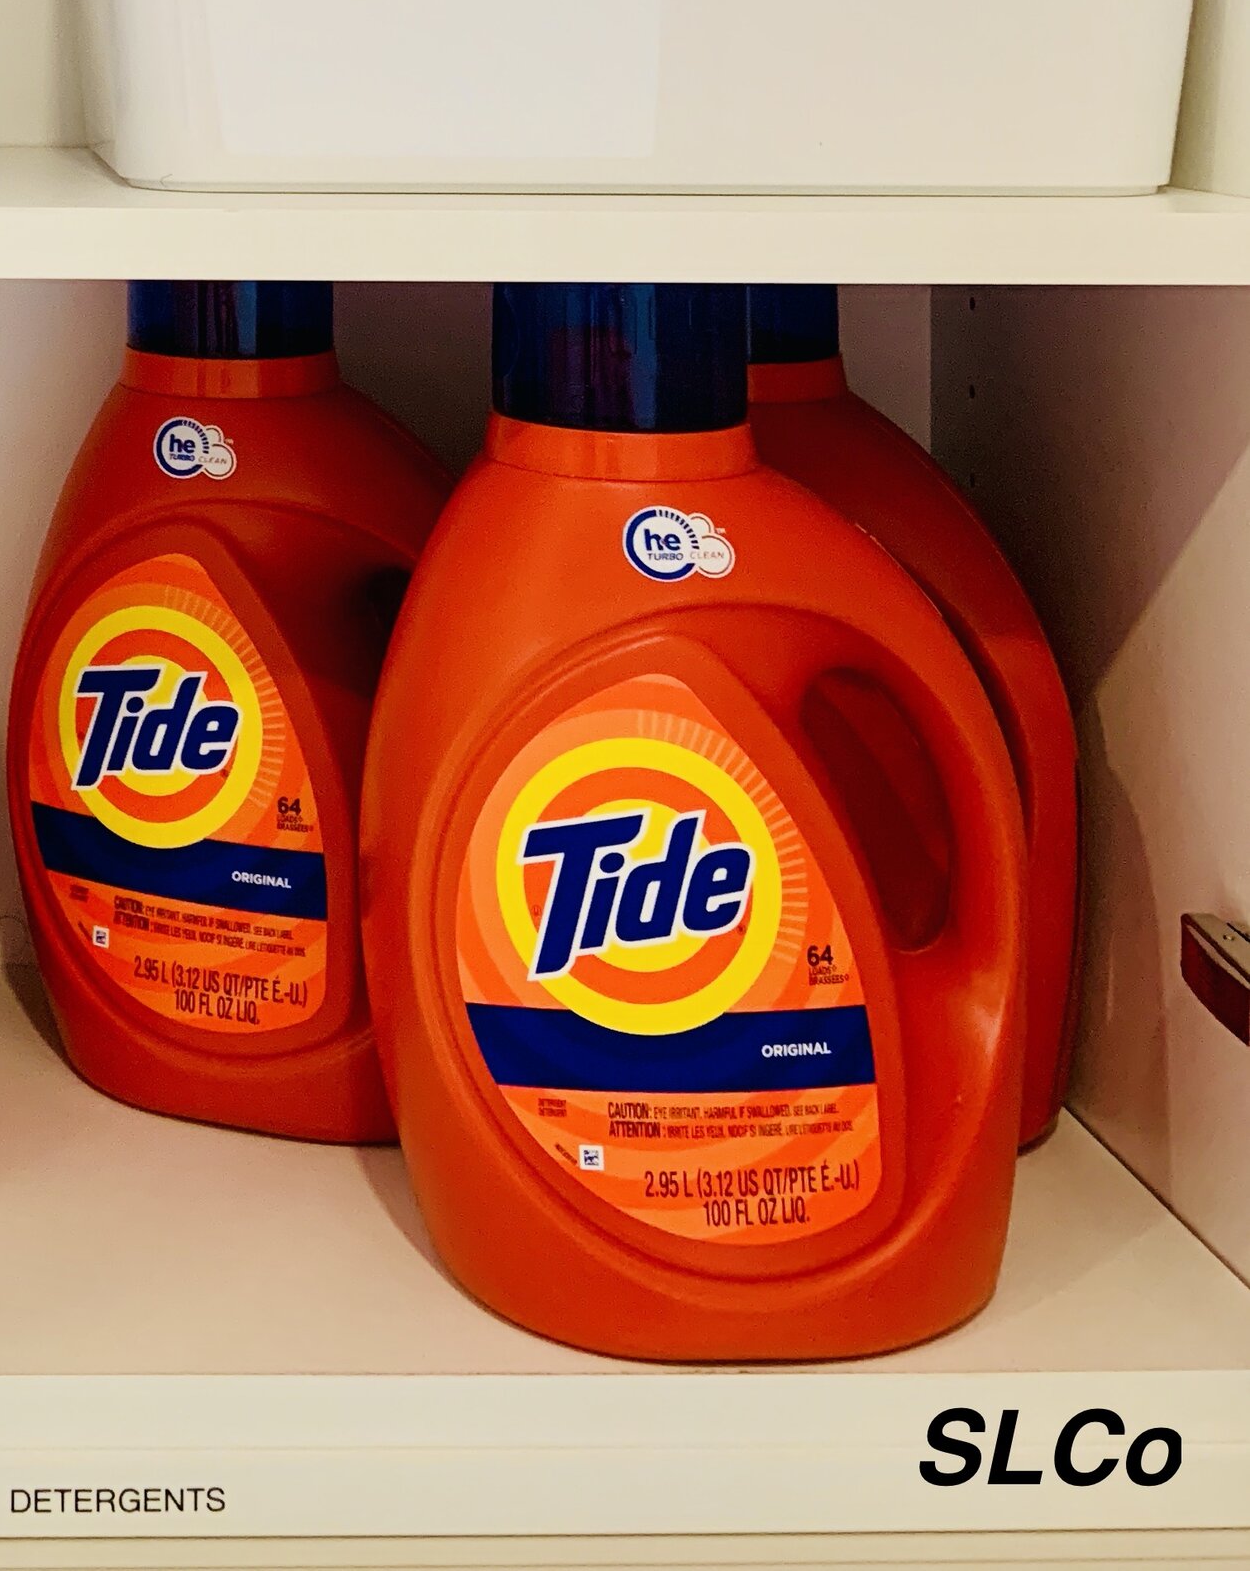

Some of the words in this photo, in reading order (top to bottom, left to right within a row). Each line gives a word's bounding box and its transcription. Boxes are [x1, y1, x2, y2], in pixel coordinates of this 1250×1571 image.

[169, 433, 196, 454] he
[169, 453, 196, 462] TURBO
[198, 455, 228, 465] CLEAN
[643, 528, 681, 552] he
[646, 551, 684, 562] TURBO
[689, 550, 725, 561] CLEAN
[74, 667, 240, 788] Tide
[277, 796, 302, 816] 64
[231, 870, 291, 889] ORIGINAL
[520, 812, 752, 976] Tide
[807, 944, 834, 967] 64
[133, 955, 159, 982] 2.95
[160, 961, 168, 983] L
[171, 960, 201, 990] (3.12
[203, 969, 220, 994] US
[223, 974, 269, 1002] QT/PTE
[174, 988, 196, 1013] 100
[198, 992, 213, 1017] FL
[216, 997, 232, 1020] OZ
[236, 1000, 261, 1026] LIQ.
[761, 1041, 832, 1058] ORIGINAL
[653, 1107, 667, 1119] EYE
[608, 1120, 661, 1139] ATTENTION
[645, 1170, 679, 1199] 2.95
[683, 1172, 695, 1198] L
[696, 1167, 734, 1200] (3.12
[737, 1169, 759, 1197] US
[762, 1164, 818, 1196] QT/PTE
[702, 1199, 731, 1227] 100
[735, 1199, 754, 1226] FL
[757, 1197, 778, 1225] OZ
[781, 1196, 810, 1225] LIQ.
[10, 1486, 226, 1513] DETERGENTS
